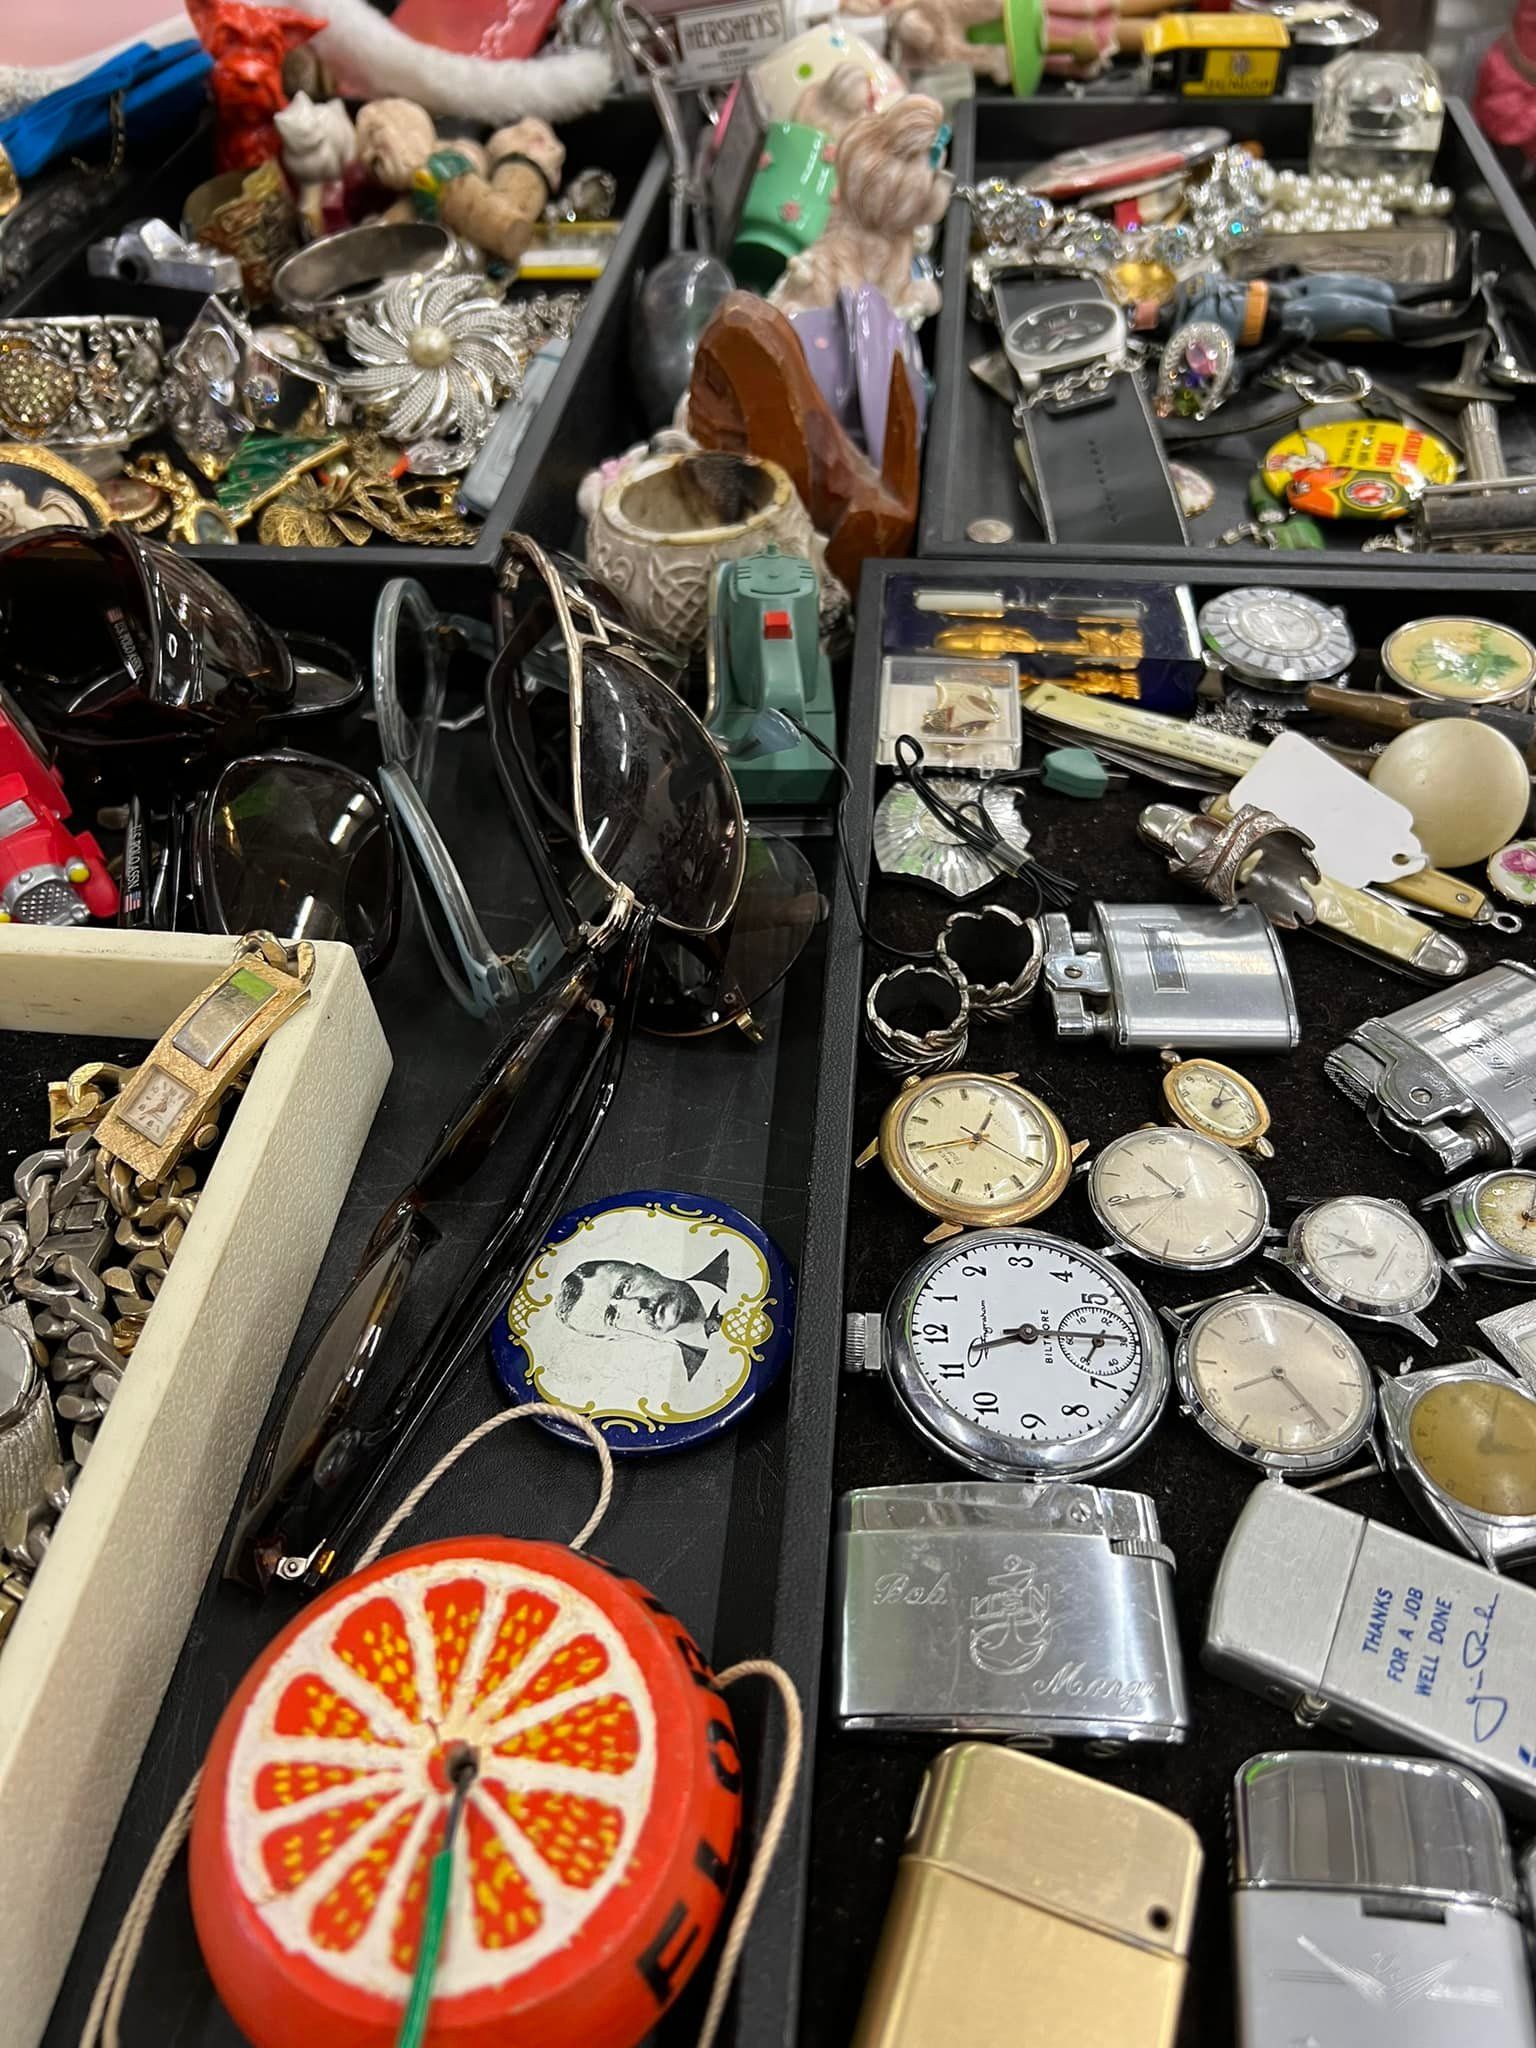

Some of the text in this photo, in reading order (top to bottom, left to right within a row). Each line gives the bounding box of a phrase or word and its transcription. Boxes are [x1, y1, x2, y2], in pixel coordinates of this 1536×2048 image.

[1008, 1256, 1034, 1268] 3
[962, 1265, 988, 1277] 2
[1049, 1270, 1073, 1283] 4
[933, 1294, 958, 1303] 1
[1081, 1293, 1109, 1306] 5
[923, 1323, 949, 1344] 12
[1040, 1308, 1054, 1364] BILTORE
[939, 1362, 965, 1379] 11
[1090, 1375, 1118, 1390] 7
[973, 1391, 999, 1415] 10
[1061, 1404, 1089, 1417] 8
[1020, 1413, 1047, 1429] 9
[873, 1571, 950, 1606] Bob
[1362, 1587, 1393, 1654] THANKS
[1387, 1587, 1424, 1683] FOR A JOB
[1414, 1596, 1453, 1697] WELL DONE
